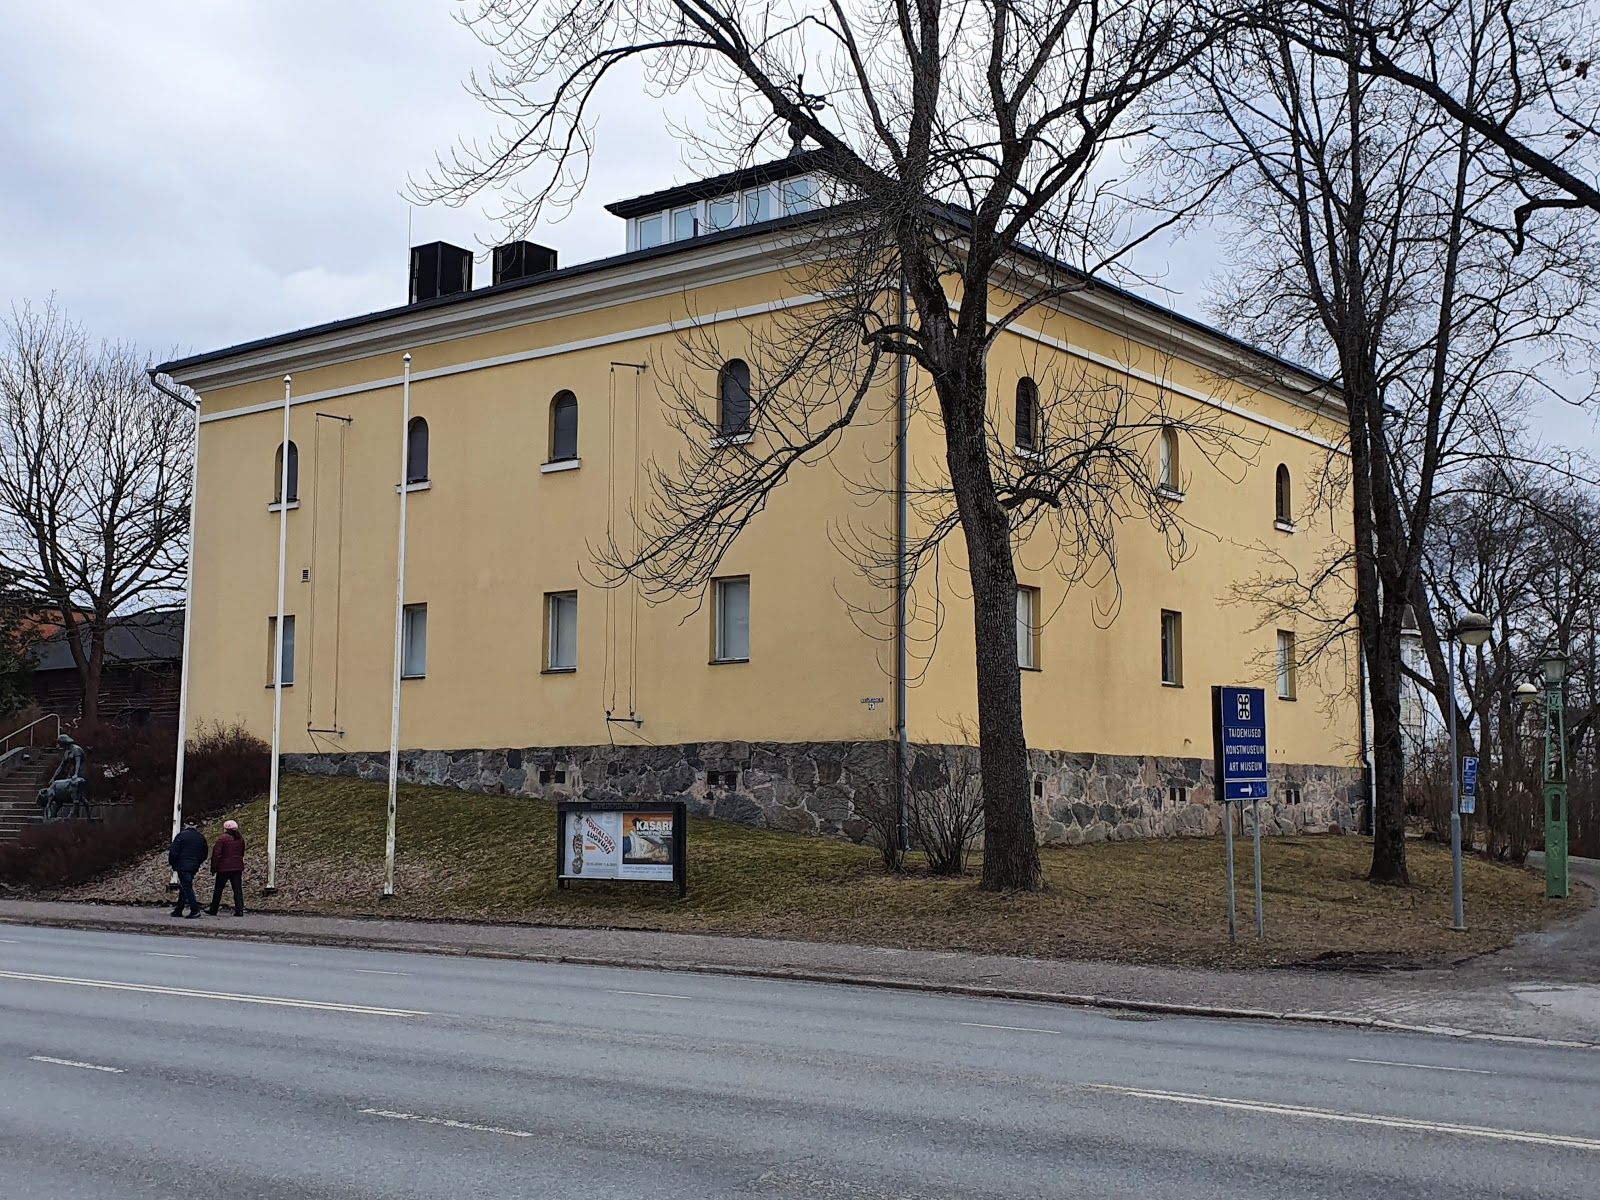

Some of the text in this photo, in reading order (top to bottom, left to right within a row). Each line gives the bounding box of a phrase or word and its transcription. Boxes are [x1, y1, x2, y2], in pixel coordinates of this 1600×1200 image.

[1228, 728, 1262, 738] TAIDEMUSEO
[1225, 744, 1265, 755] KONSTMUSEUM
[1228, 761, 1263, 772] ART MUSEUM
[1465, 758, 1476, 770] P
[636, 820, 673, 831] KASARI
